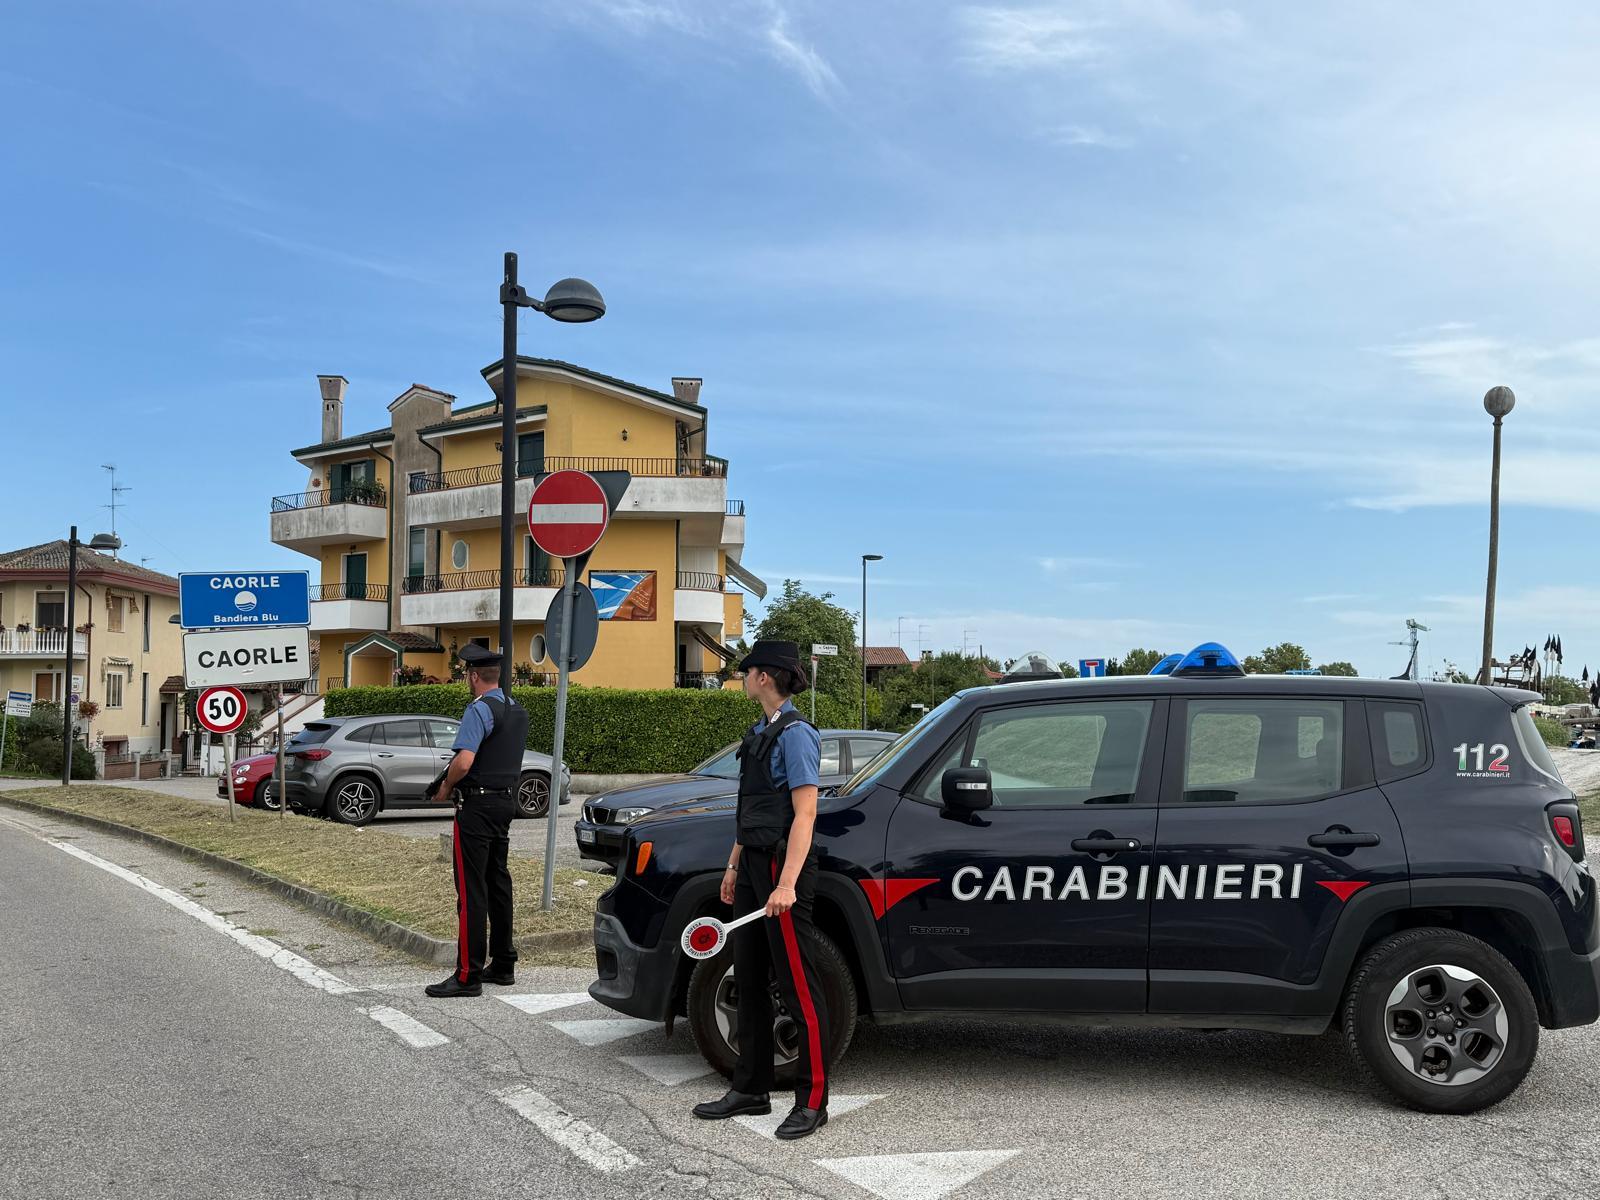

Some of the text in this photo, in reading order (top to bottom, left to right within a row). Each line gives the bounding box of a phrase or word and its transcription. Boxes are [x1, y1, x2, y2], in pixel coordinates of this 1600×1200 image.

[210, 576, 280, 589] CAORLE
[214, 613, 279, 623] Bandiera Blu
[198, 646, 298, 669] CAORLE
[209, 696, 237, 720] 50
[1453, 743, 1510, 772] 112
[951, 863, 1304, 901] CARABINIERI
